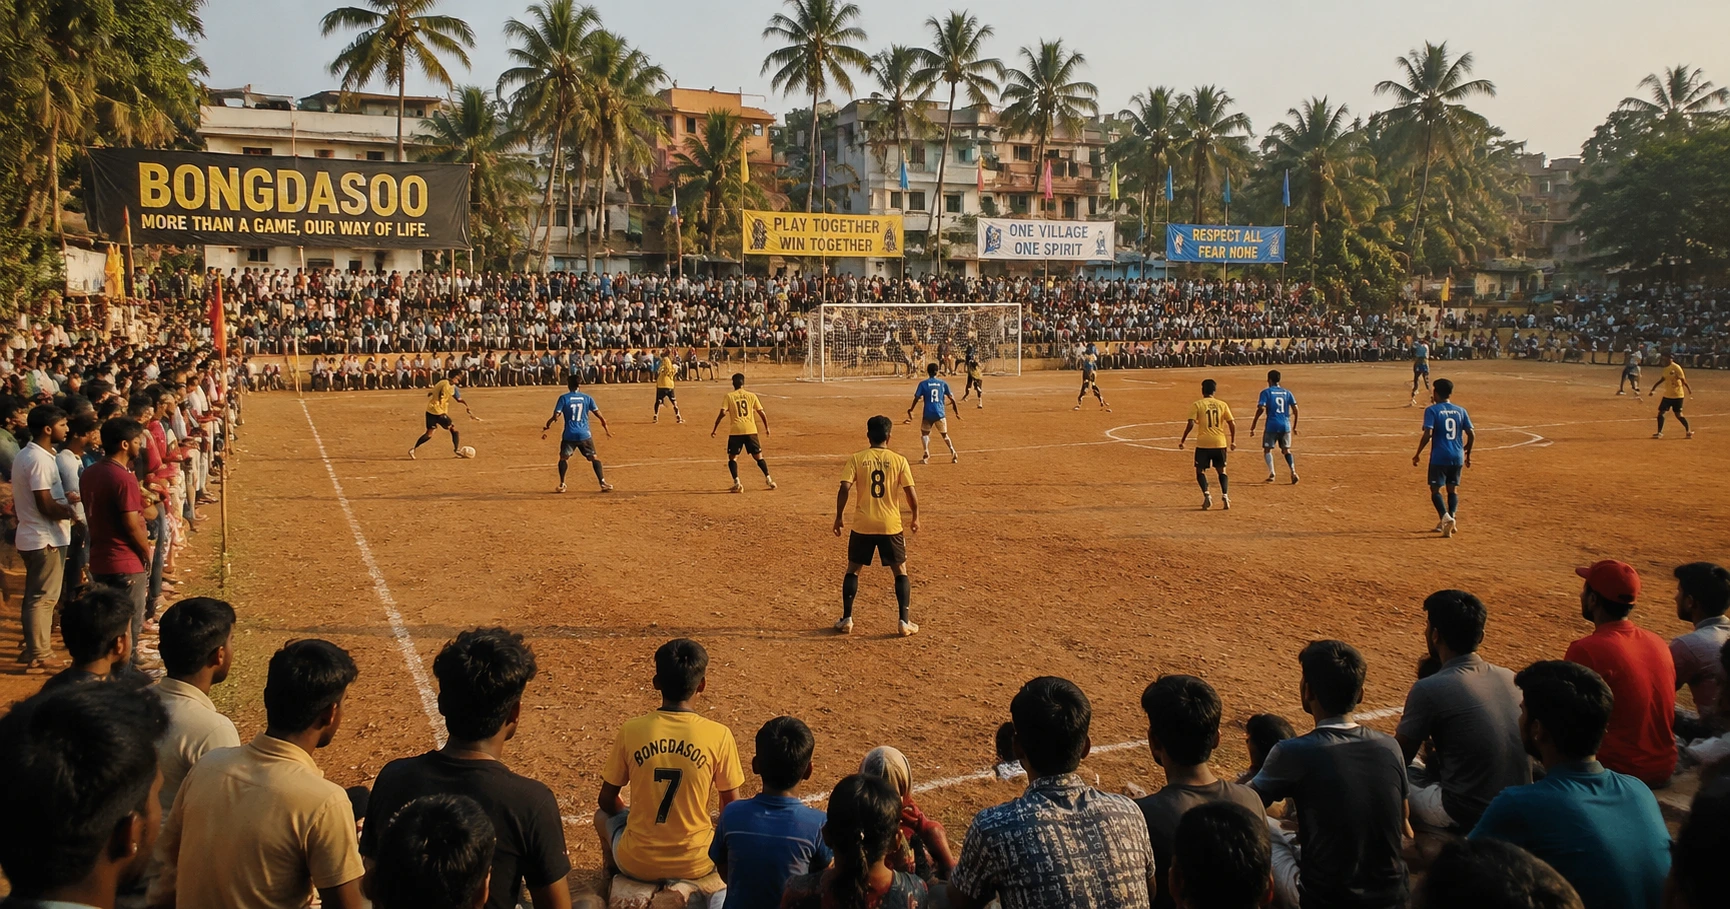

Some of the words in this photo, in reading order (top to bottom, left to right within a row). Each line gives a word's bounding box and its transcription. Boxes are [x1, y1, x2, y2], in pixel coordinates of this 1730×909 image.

[138, 161, 429, 218] BONGDASOO
[141, 213, 188, 230] MORE
[192, 215, 234, 232] THAN
[238, 217, 250, 233] A
[253, 217, 300, 236] GAME,
[304, 219, 336, 235] OUR
[339, 220, 371, 236] WAY
[374, 221, 393, 236] OF
[397, 222, 430, 237] LIFE.
[773, 217, 807, 232] PLAY
[812, 218, 880, 234] TOGETHER
[1009, 223, 1034, 238] ONE
[1038, 224, 1089, 239] VILLAGE
[779, 236, 805, 250] WIN
[810, 237, 873, 252] TOGETHER
[1192, 228, 1241, 242] RESPECT
[1243, 230, 1264, 243] ALL
[1014, 241, 1040, 255] ONE
[1043, 242, 1083, 256] SPIRIT
[1198, 245, 1226, 258] FEAR
[1275, 397, 1285, 414] 9
[1445, 417, 1457, 440] 9
[870, 468, 886, 499] 8
[633, 738, 708, 770] BONGDASOO
[653, 767, 683, 825] 7
